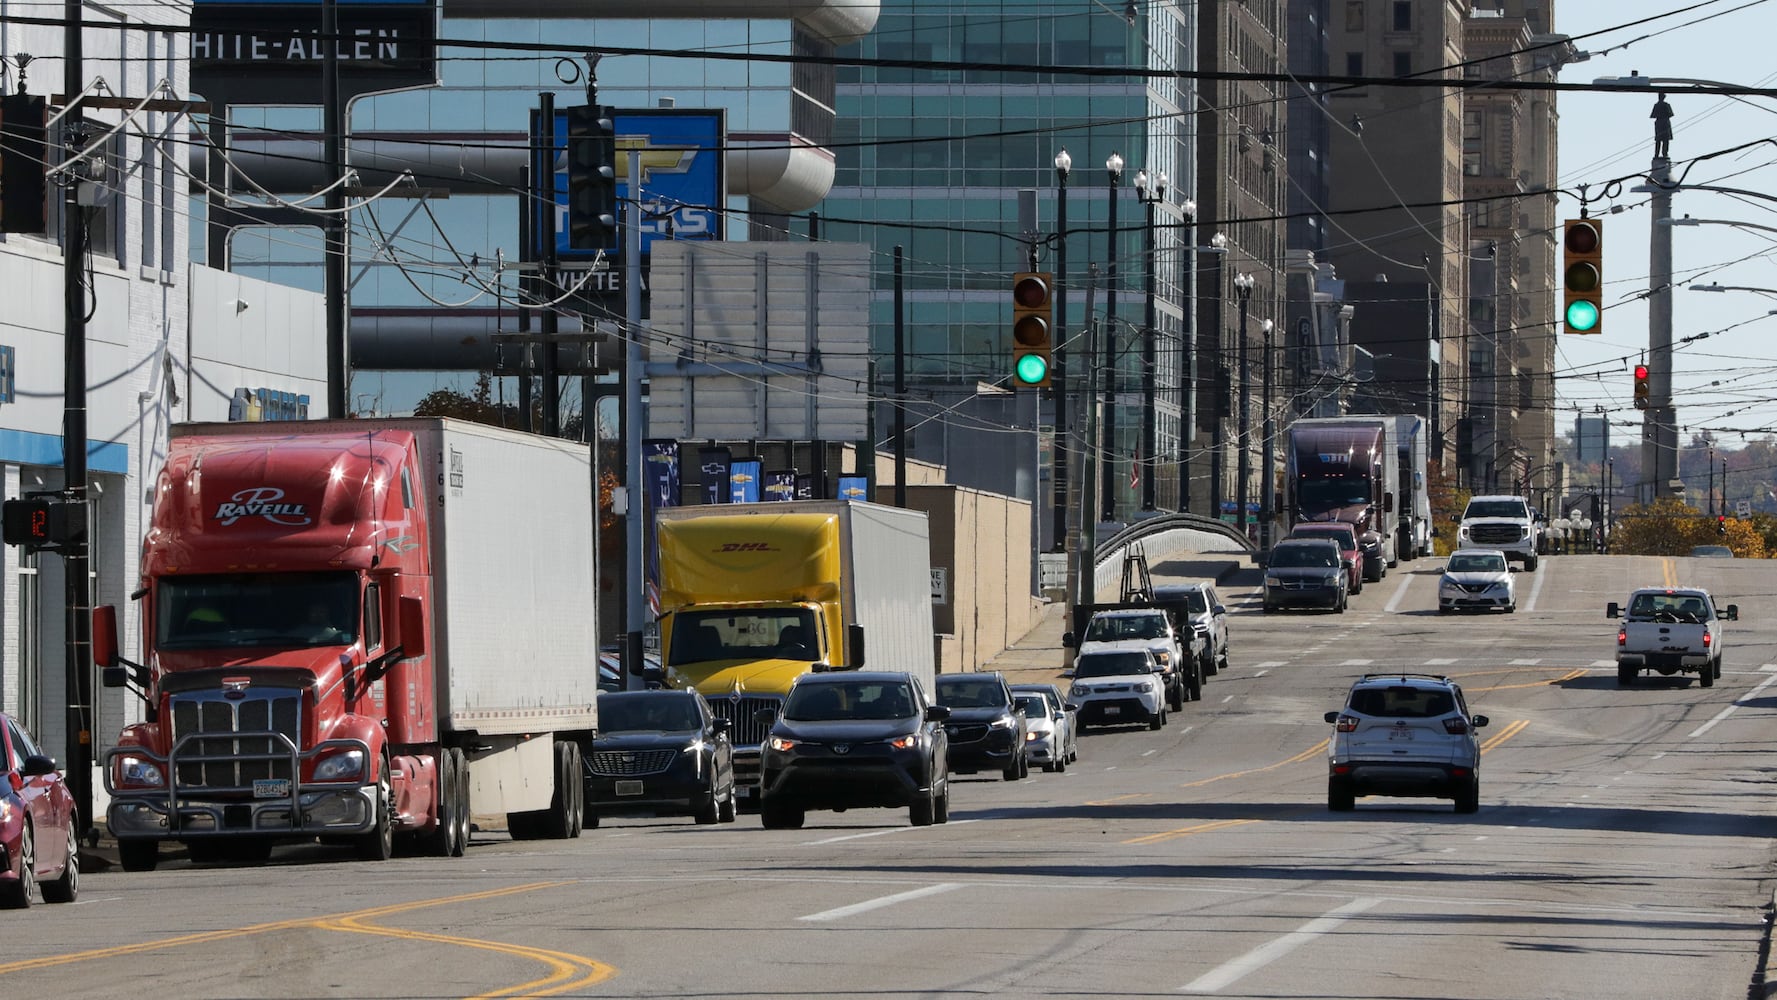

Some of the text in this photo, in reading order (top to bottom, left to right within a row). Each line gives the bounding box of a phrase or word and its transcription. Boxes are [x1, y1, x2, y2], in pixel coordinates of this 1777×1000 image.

[215, 503, 304, 518] RAVEILL
[32, 510, 46, 537] 12
[721, 543, 770, 552] DHL
